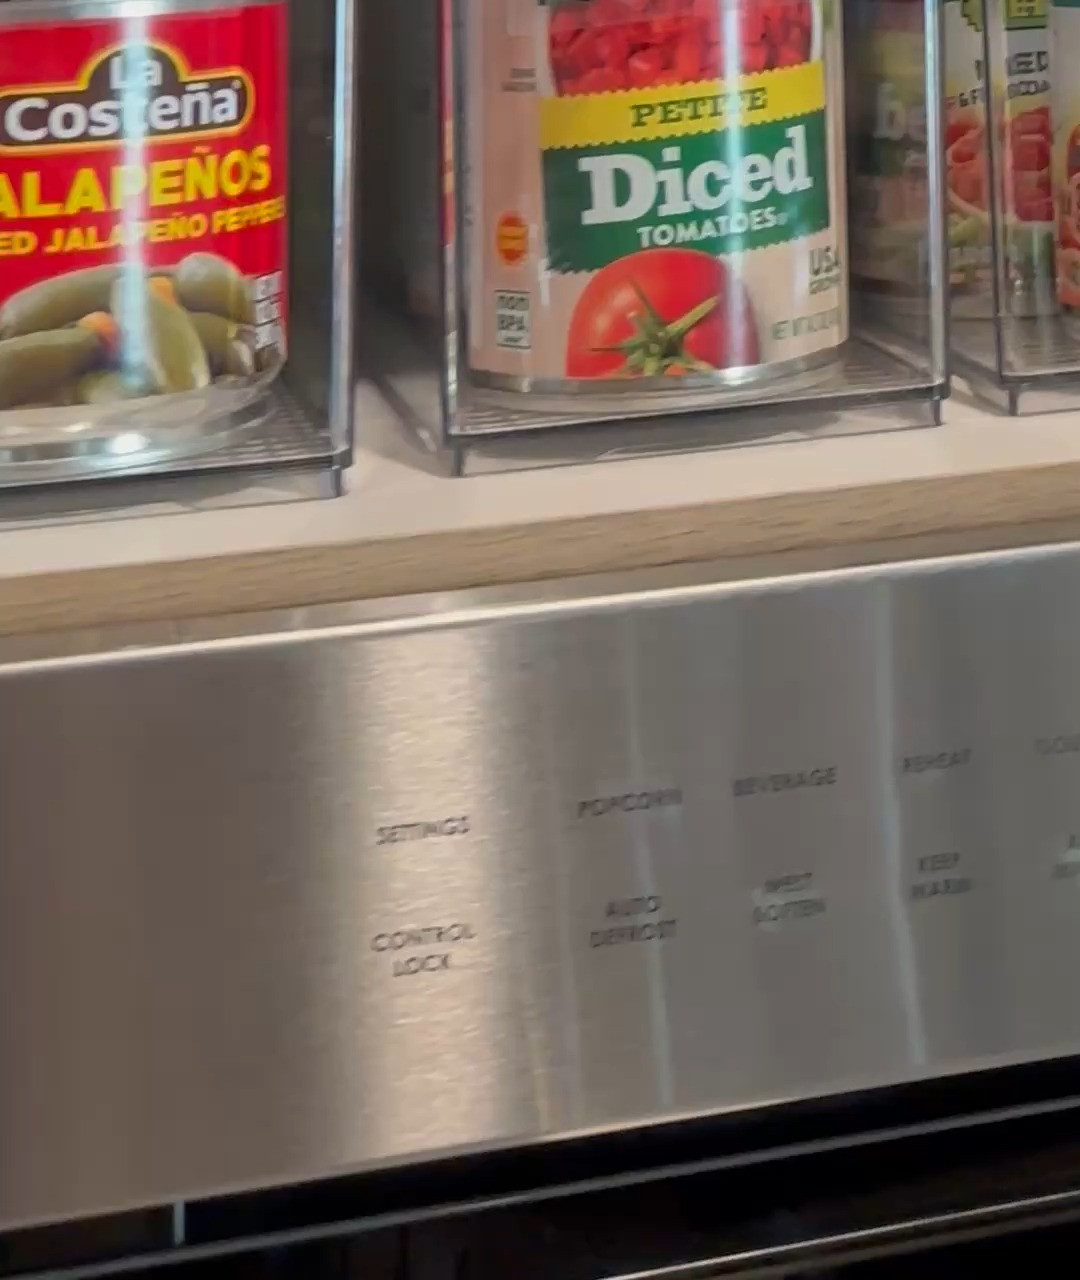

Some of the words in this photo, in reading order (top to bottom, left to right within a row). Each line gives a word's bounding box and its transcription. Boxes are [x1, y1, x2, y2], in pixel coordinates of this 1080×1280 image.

[109, 54, 163, 90] La
[3, 80, 240, 142] Costeña
[629, 86, 770, 129] PETITE
[577, 125, 815, 225] Diced
[637, 206, 777, 250] TOMATOES
[370, 923, 476, 953] CONTROL
[393, 953, 450, 978] LOCK
